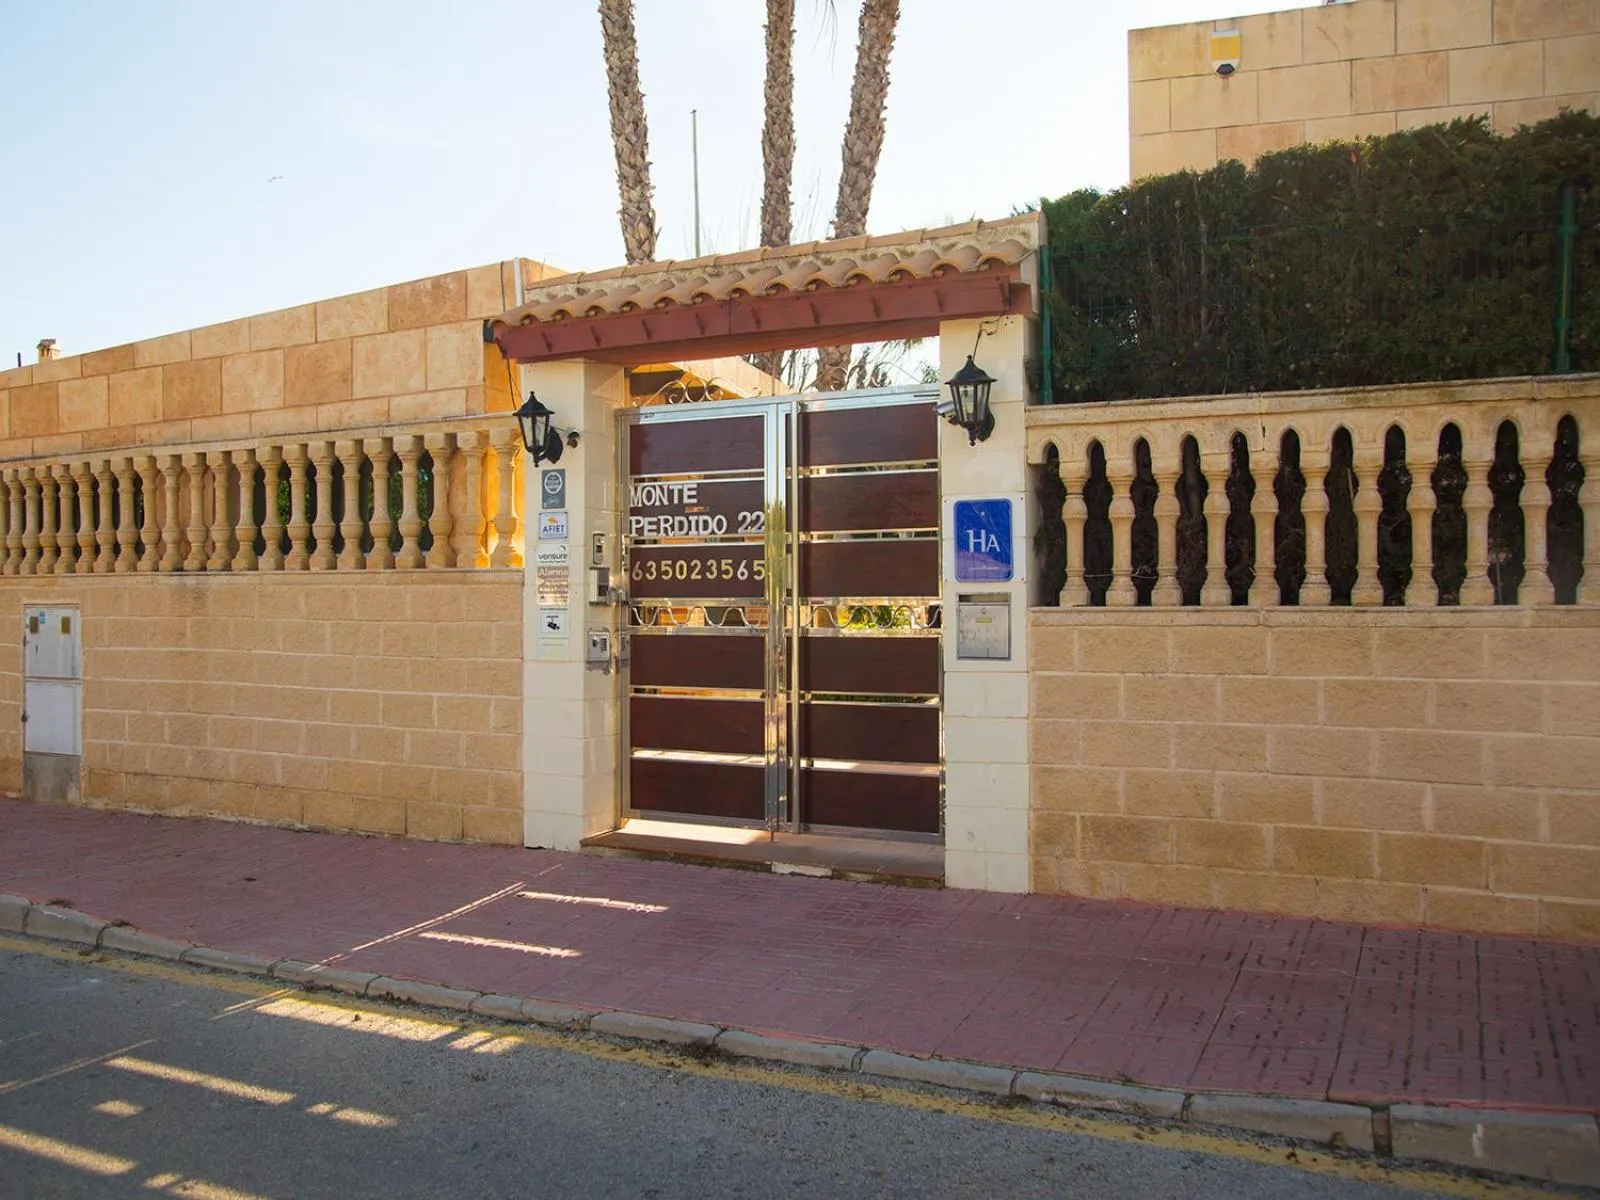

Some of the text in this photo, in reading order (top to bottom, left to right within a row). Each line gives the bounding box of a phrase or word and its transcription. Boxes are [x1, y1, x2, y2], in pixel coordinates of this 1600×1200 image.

[629, 483, 698, 508] MONTE
[629, 511, 766, 538] PERDIDO 22
[632, 559, 766, 581] 635023565
